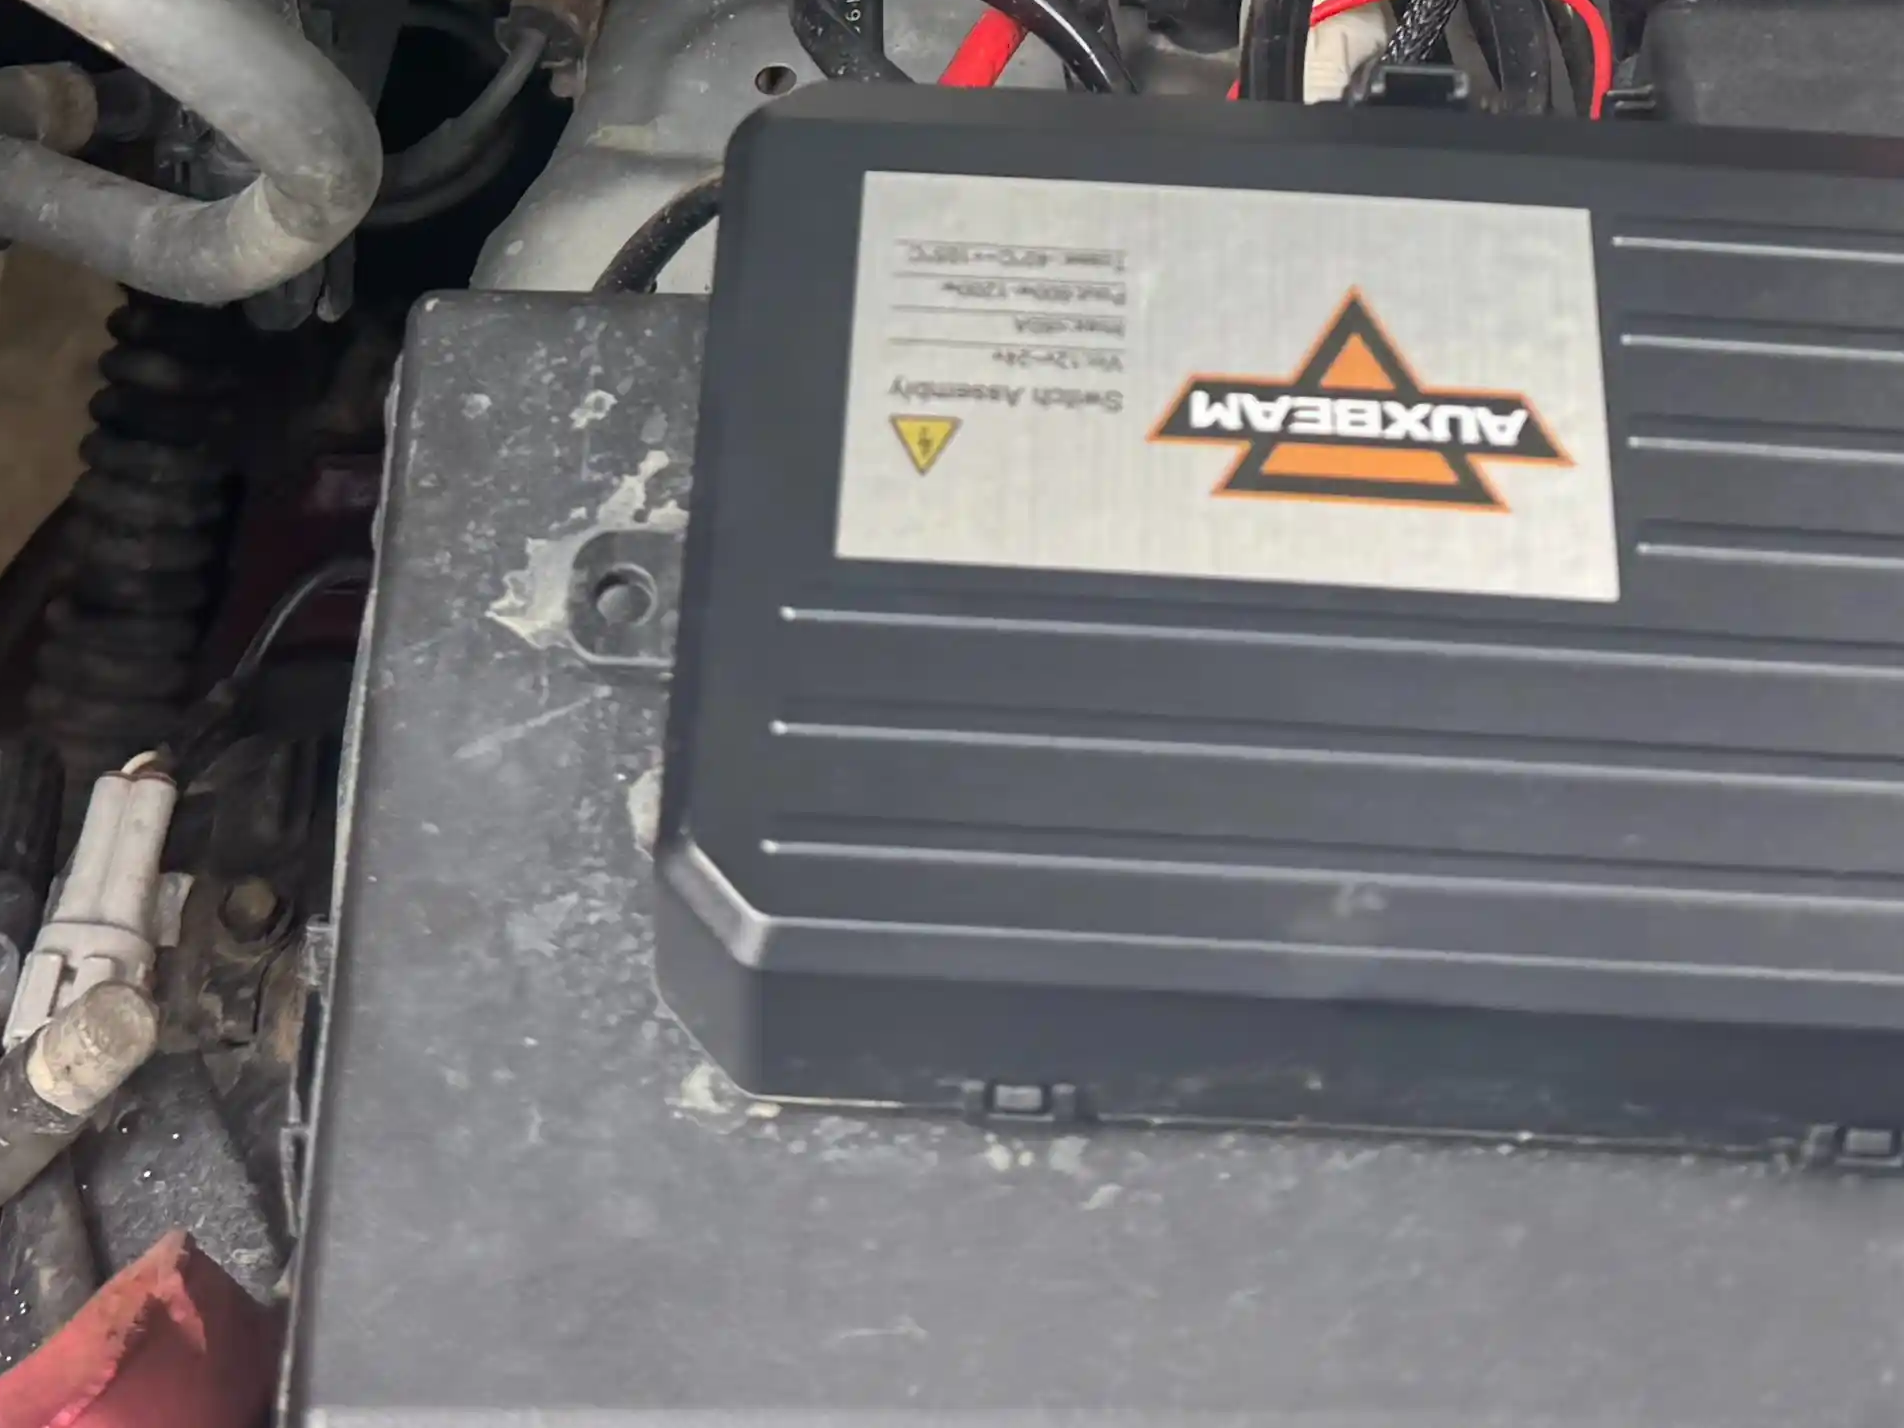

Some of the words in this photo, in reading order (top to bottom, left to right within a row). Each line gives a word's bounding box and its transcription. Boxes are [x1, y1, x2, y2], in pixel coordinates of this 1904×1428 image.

[887, 375, 1025, 408] Assembly
[1032, 387, 1125, 414] Switch
[1188, 392, 1528, 445] AUXBEAM
